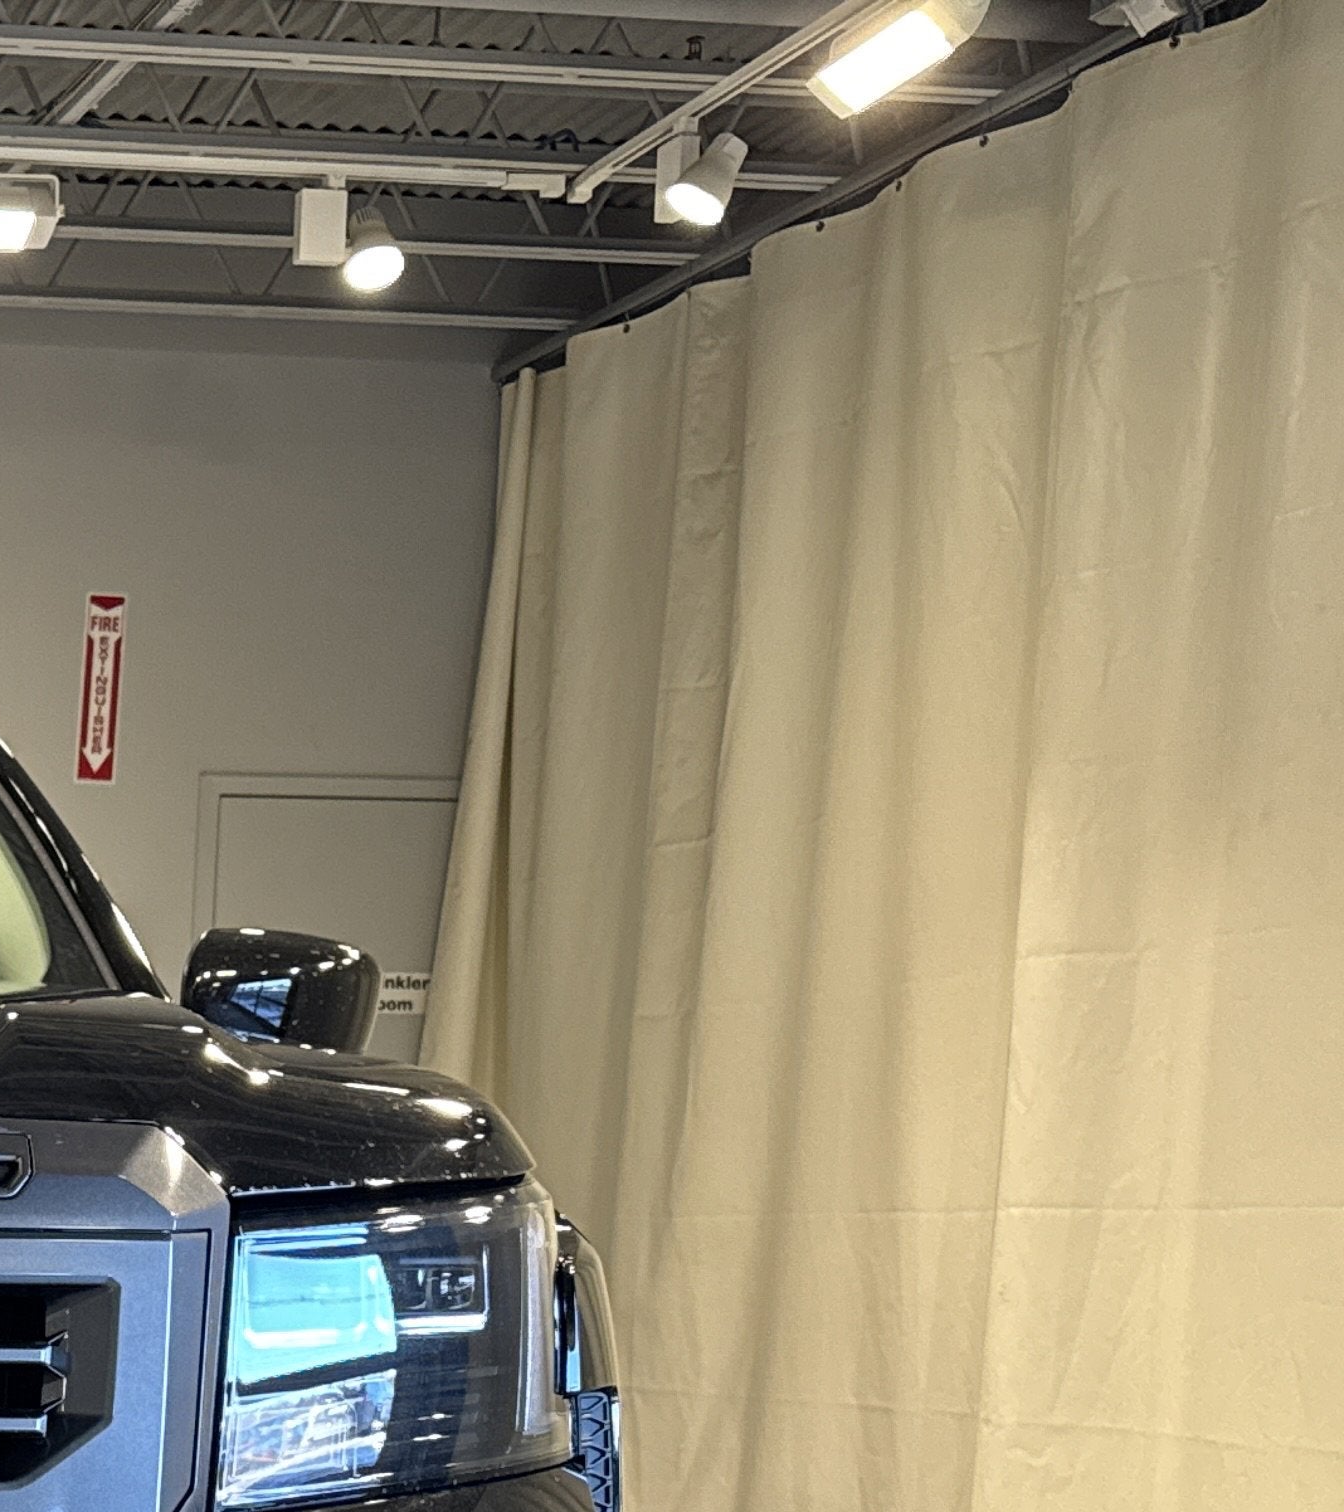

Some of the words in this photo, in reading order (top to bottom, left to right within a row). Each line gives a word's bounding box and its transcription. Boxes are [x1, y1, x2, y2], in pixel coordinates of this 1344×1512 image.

[89, 615, 120, 633] FIRE
[383, 975, 431, 991] nkler
[378, 999, 413, 1011] oom
